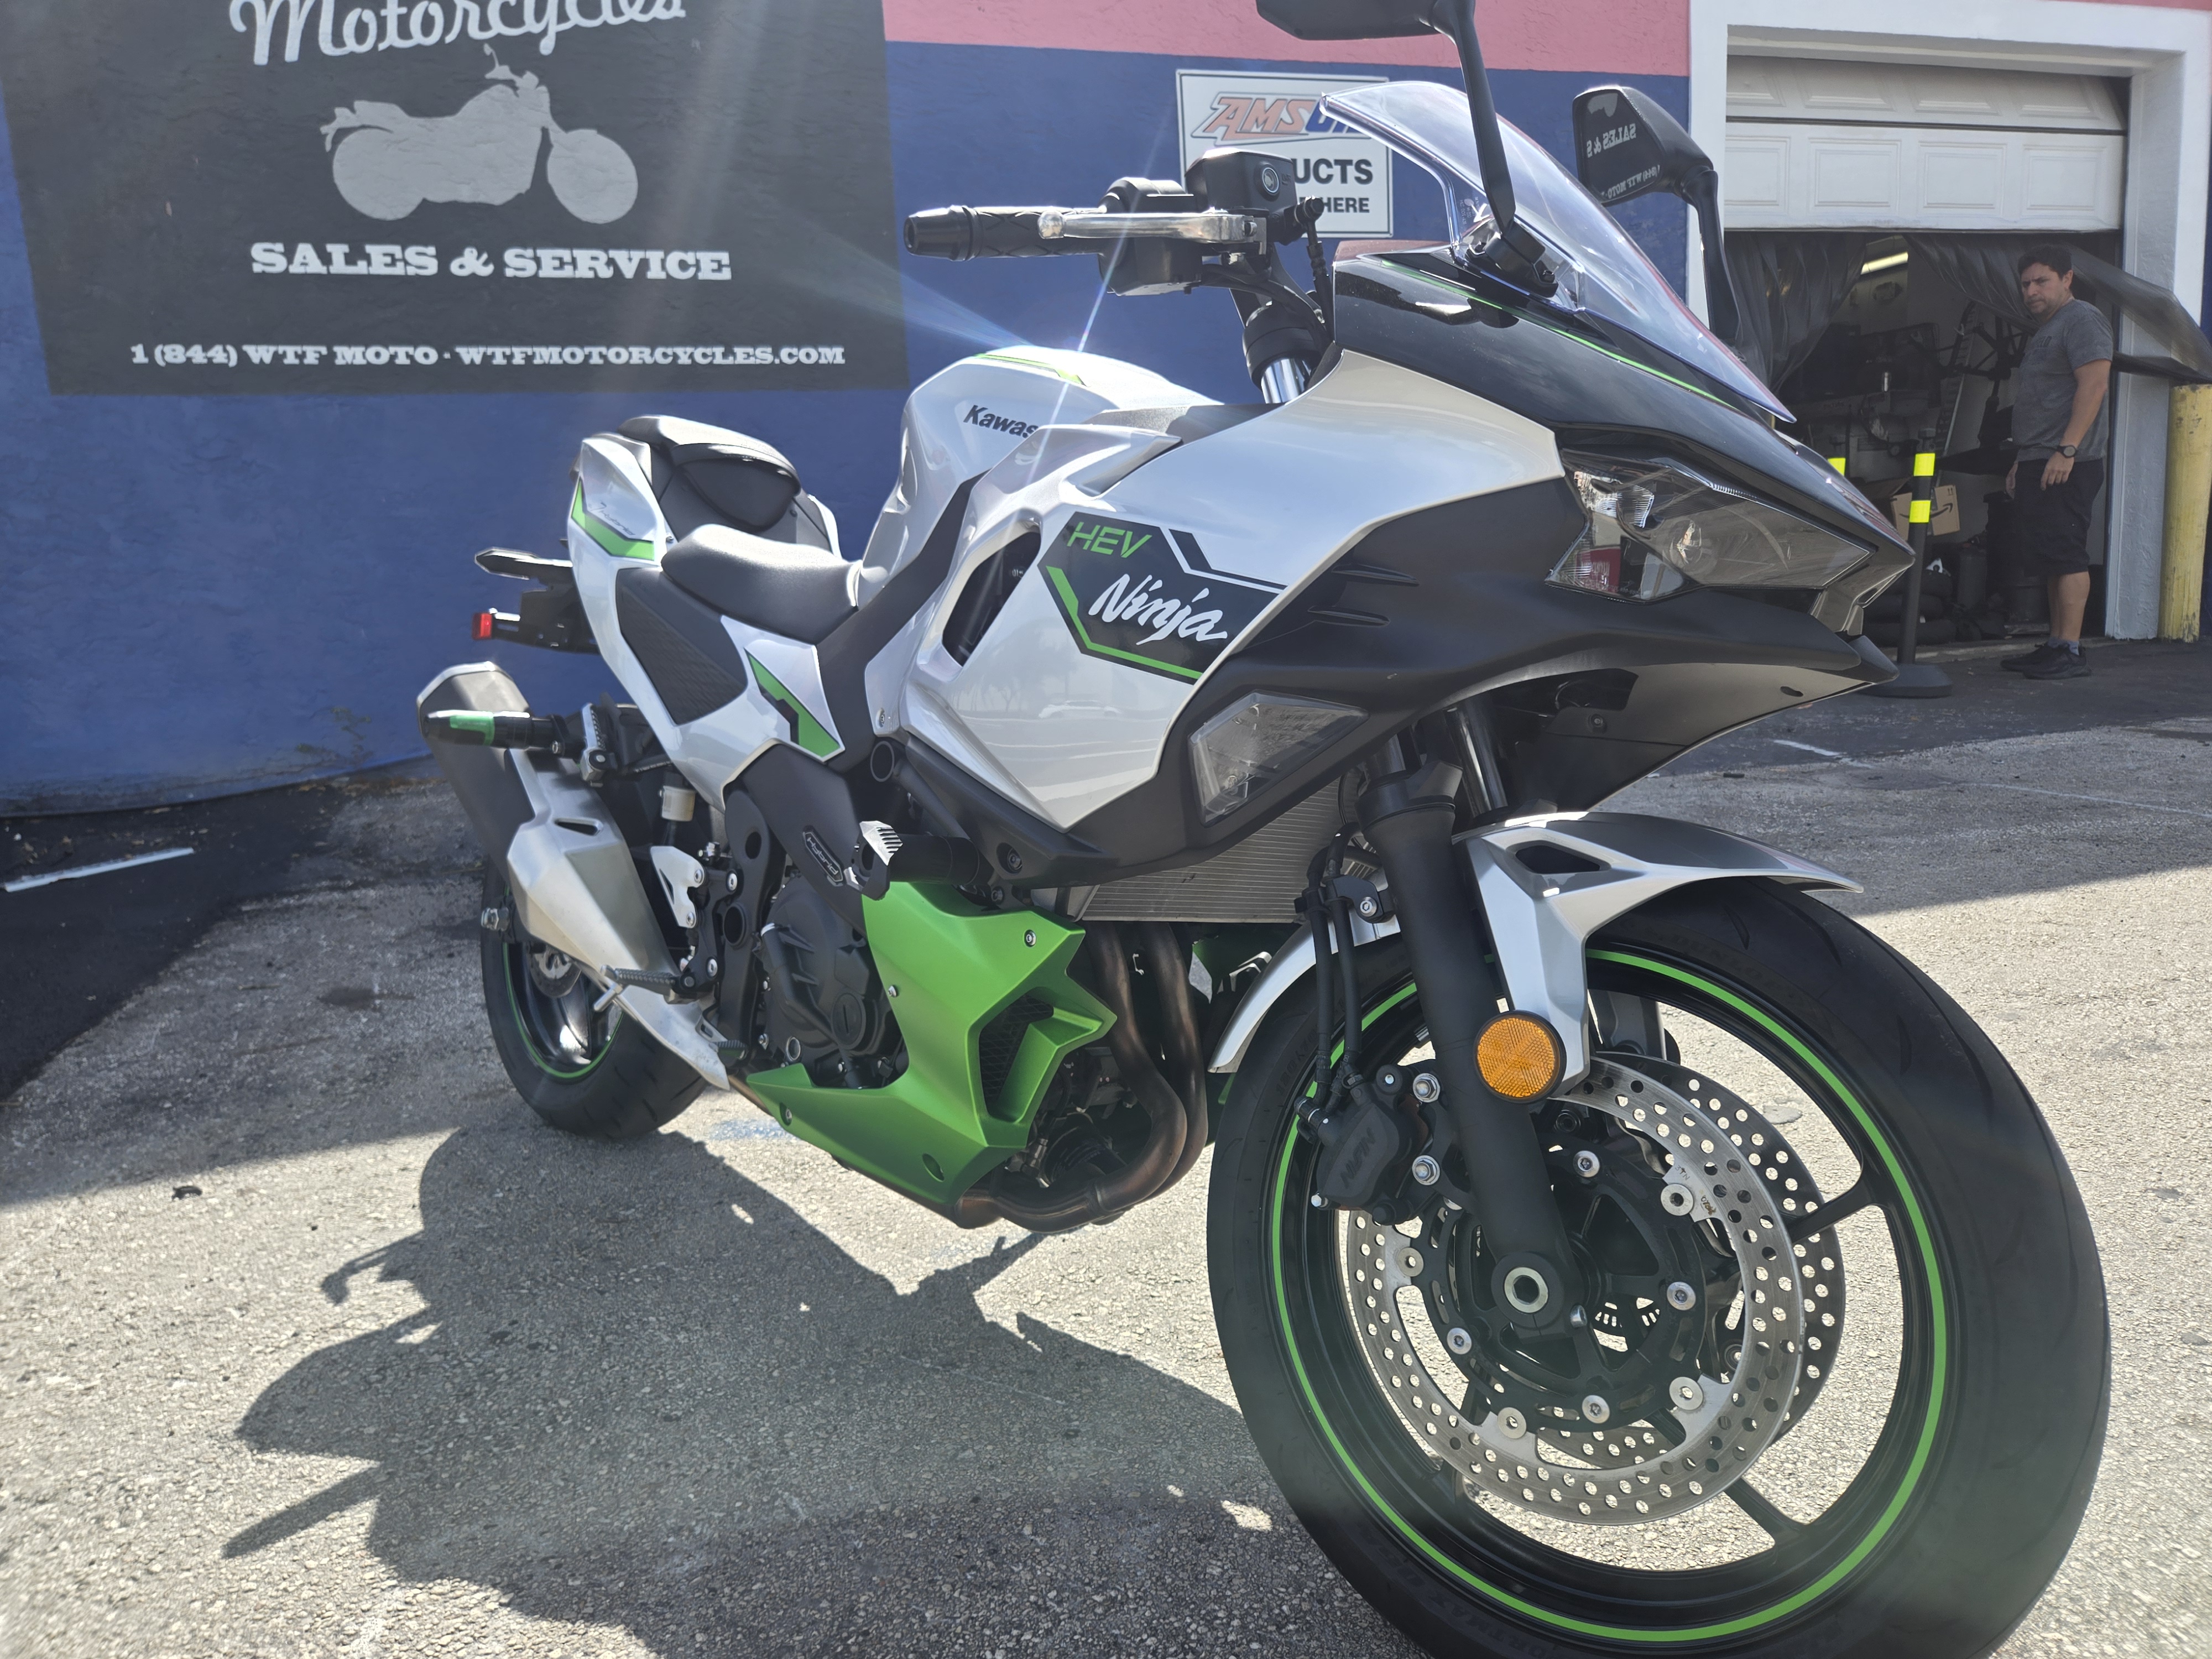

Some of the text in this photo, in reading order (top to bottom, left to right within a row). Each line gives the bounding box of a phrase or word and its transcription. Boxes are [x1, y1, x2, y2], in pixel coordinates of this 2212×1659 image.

[1202, 96, 1359, 141] AMSO
[1291, 158, 1373, 185] UCTS
[251, 242, 732, 280] SALES & SERVICE
[242, 345, 328, 364] WTF
[333, 346, 439, 365] MOTO
[455, 347, 846, 365] WTFMOTORCYCLES.COM
[963, 404, 1039, 439] Kawas
[1067, 521, 1152, 559] HEV
[1088, 573, 1228, 645] Ninja
[806, 836, 839, 875] Hybrid
